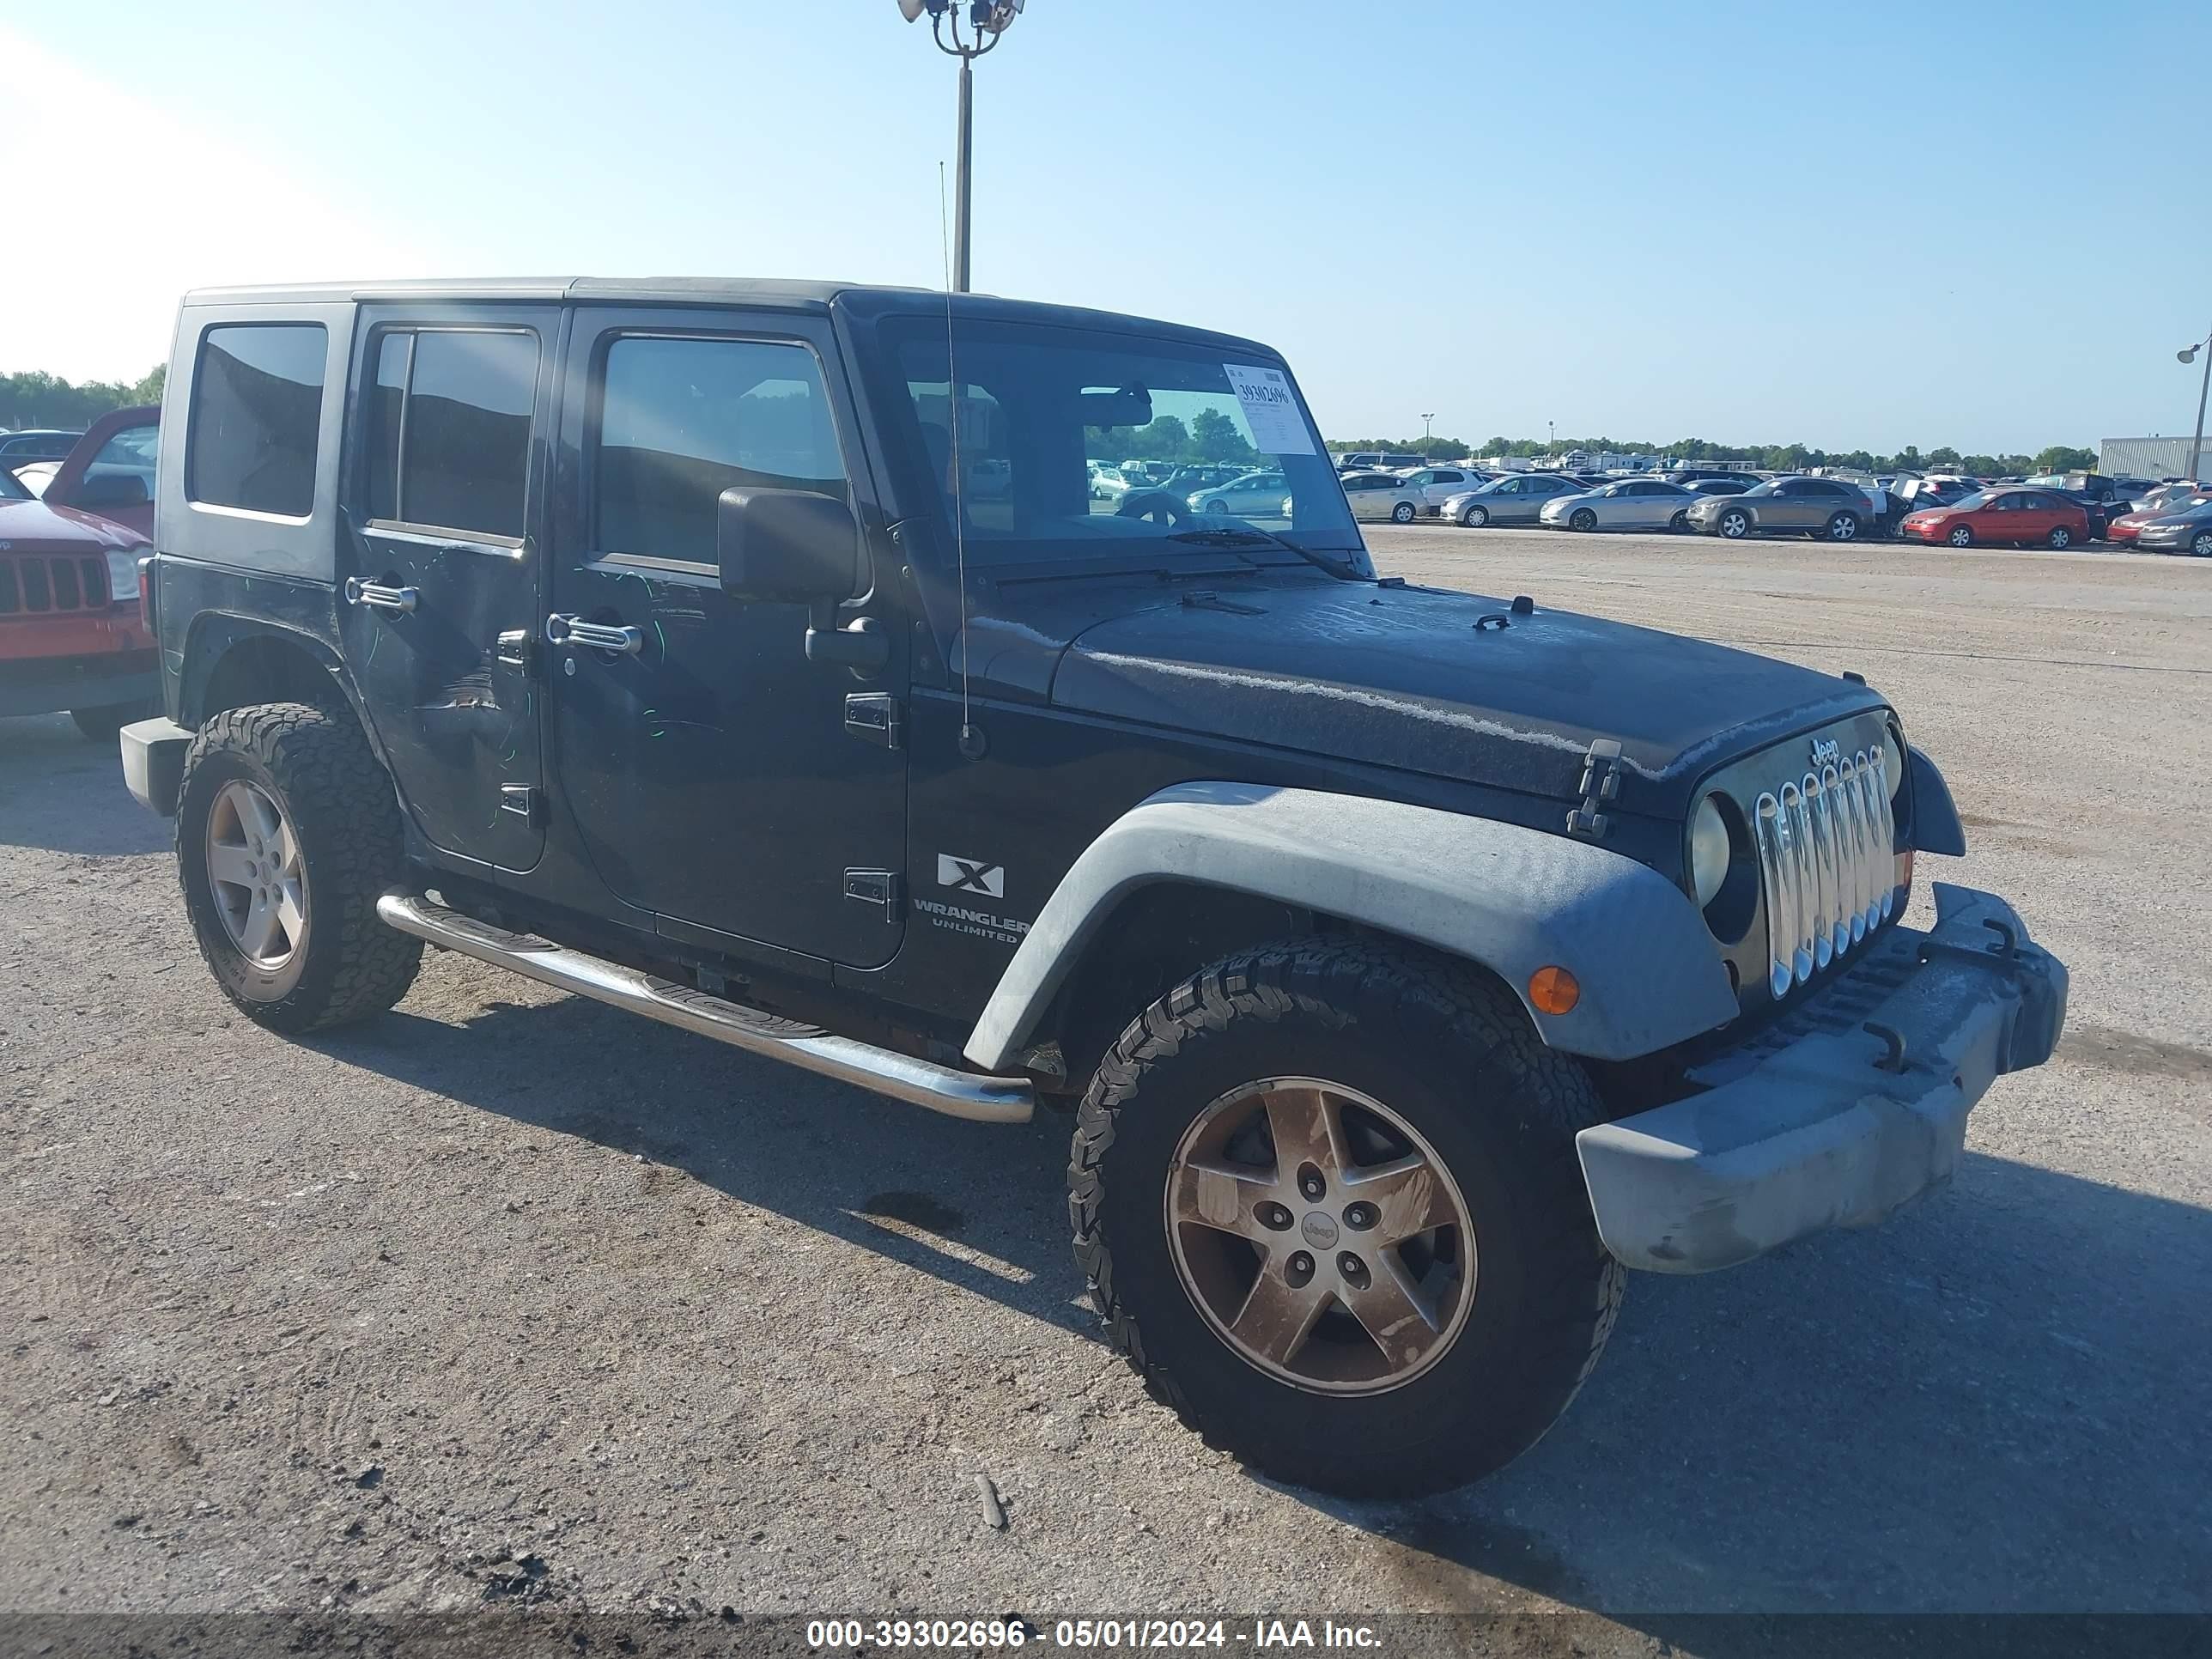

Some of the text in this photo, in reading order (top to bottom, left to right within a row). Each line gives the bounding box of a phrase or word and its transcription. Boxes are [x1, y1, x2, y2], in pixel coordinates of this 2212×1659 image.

[1239, 384, 1290, 404] 39302696
[1811, 738, 1839, 766] Jeep
[945, 858, 1000, 895] X
[914, 898, 1031, 935] WRANGLER
[932, 918, 1018, 944] UNLIMITED
[1304, 1222, 1335, 1239] Jeep
